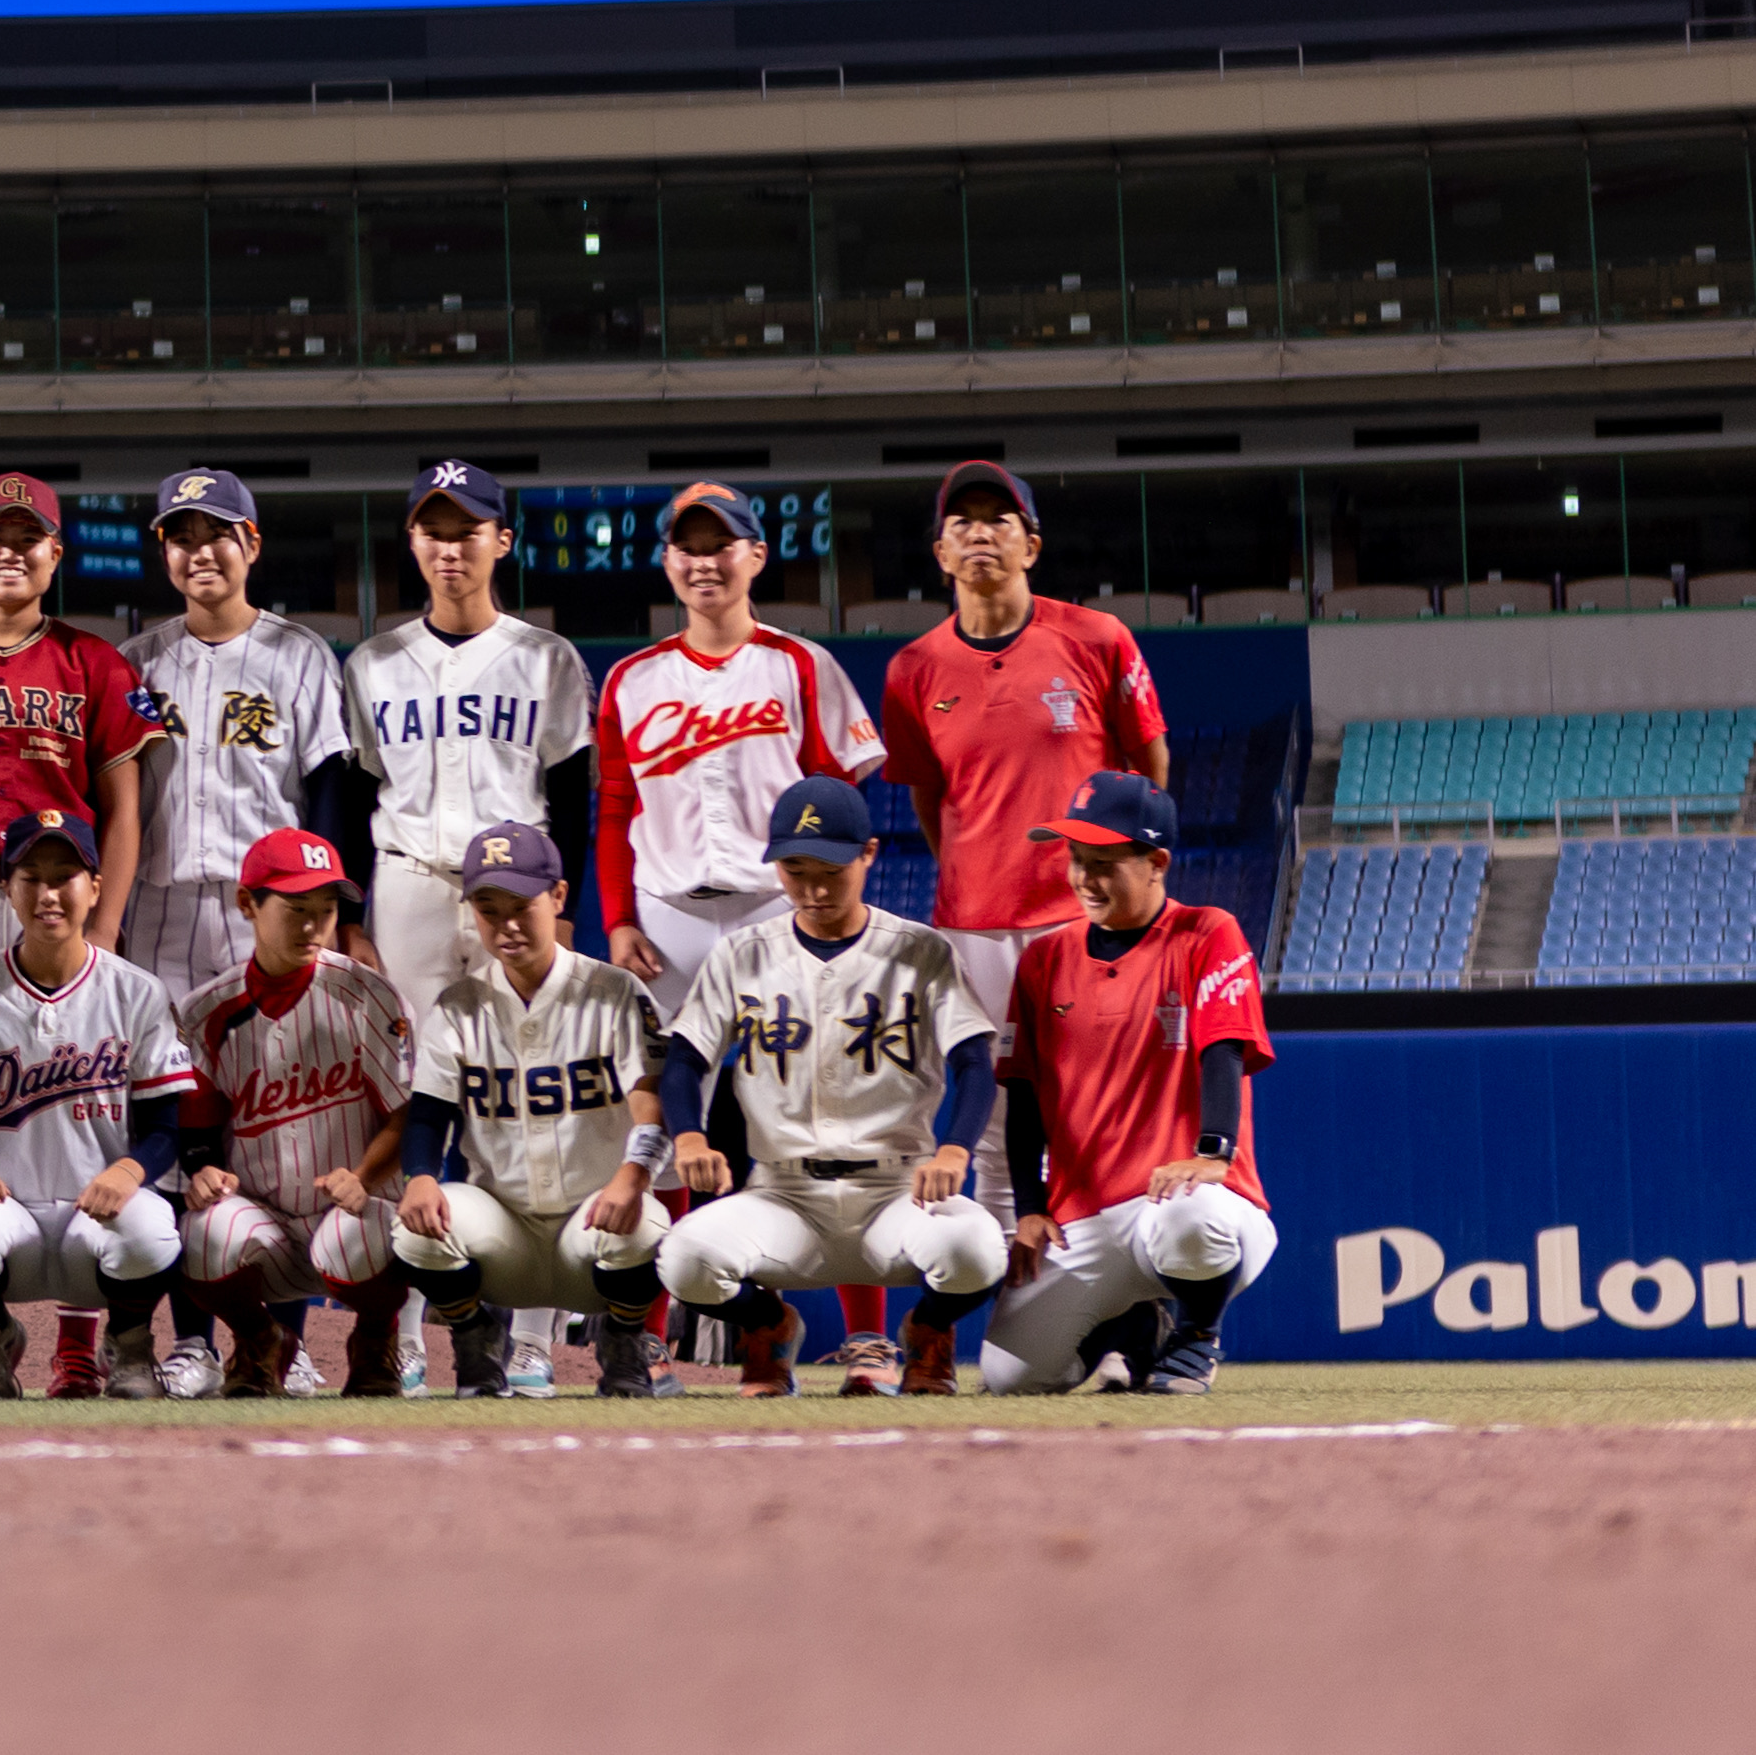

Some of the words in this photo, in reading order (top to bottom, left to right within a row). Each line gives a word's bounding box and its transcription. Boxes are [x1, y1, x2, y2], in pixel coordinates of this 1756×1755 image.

[371, 695, 539, 747] KAISHI
[626, 698, 791, 765] Chuo
[481, 837, 514, 865] R
[73, 1103, 124, 1123] GIFU
